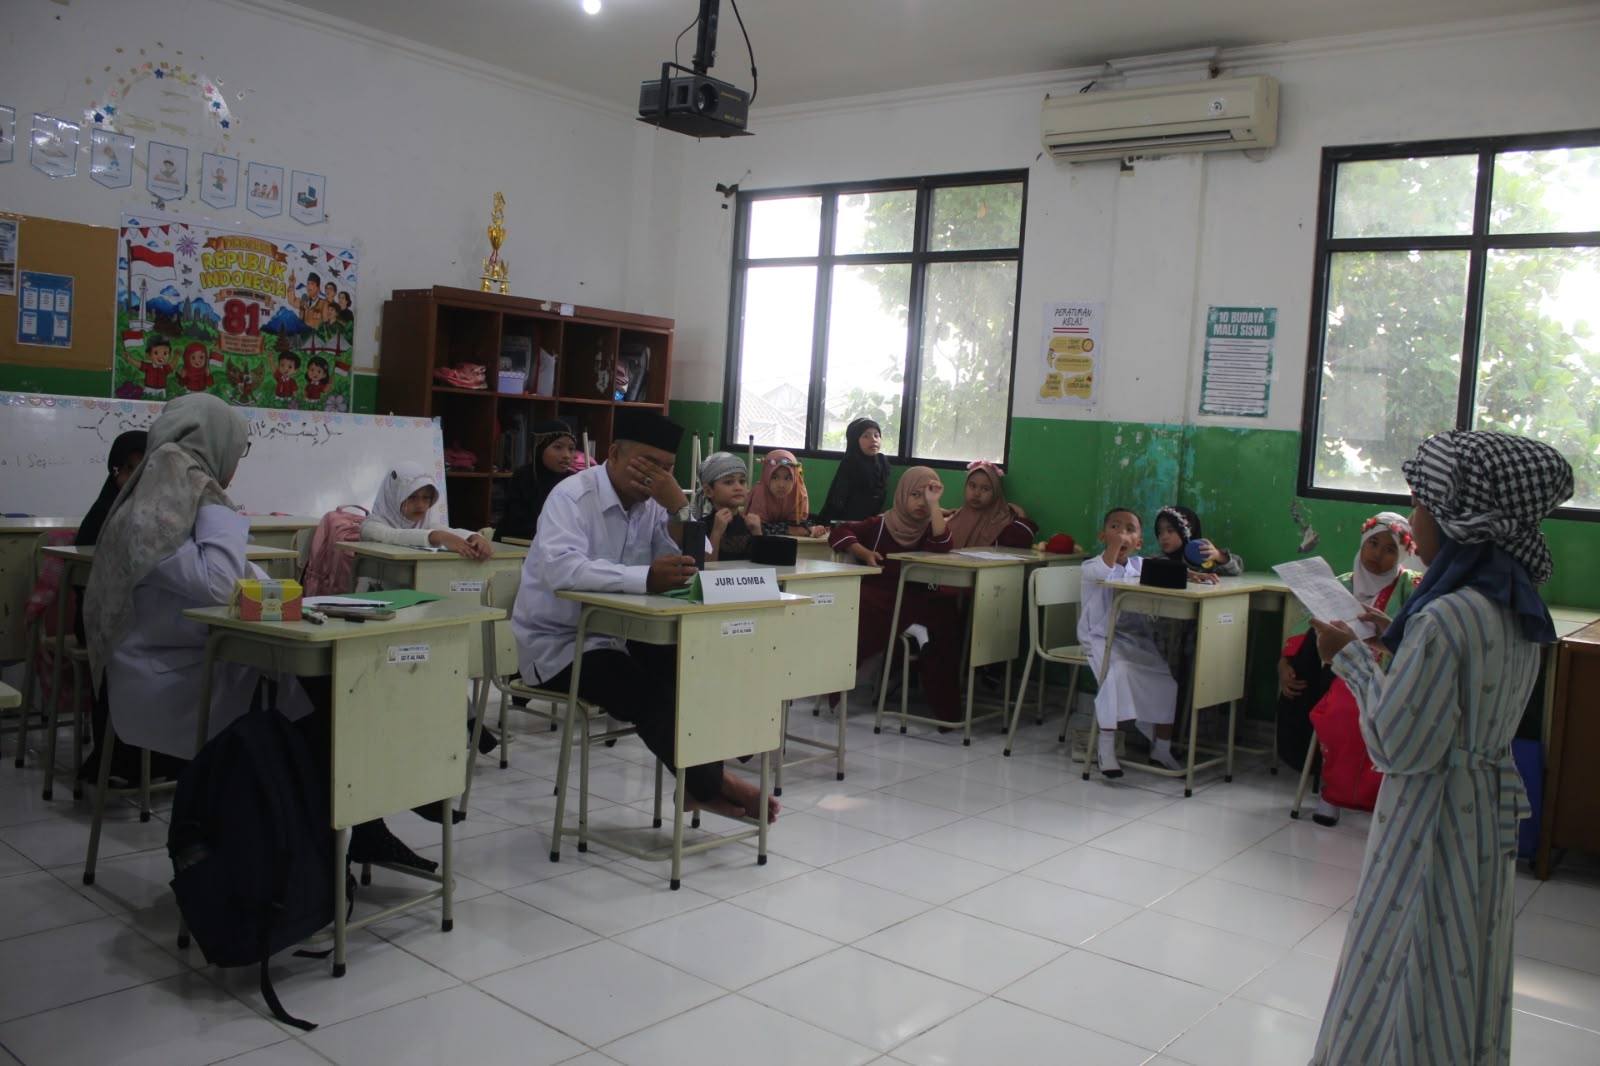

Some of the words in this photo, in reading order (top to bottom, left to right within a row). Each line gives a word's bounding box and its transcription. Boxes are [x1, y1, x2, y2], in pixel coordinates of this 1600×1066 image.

[201, 250, 287, 281] REPUBLIK
[200, 270, 287, 299] INDONESIA
[222, 298, 259, 336] 81
[1054, 307, 1092, 318] PERATURAN
[1219, 311, 1229, 323] 10
[1231, 311, 1264, 324] BUDAYA
[1062, 317, 1083, 326] KELAS
[1213, 324, 1238, 336] MALU
[1240, 324, 1268, 337] SISWA
[714, 577, 735, 586] JURI
[736, 576, 766, 586] LOMBA
